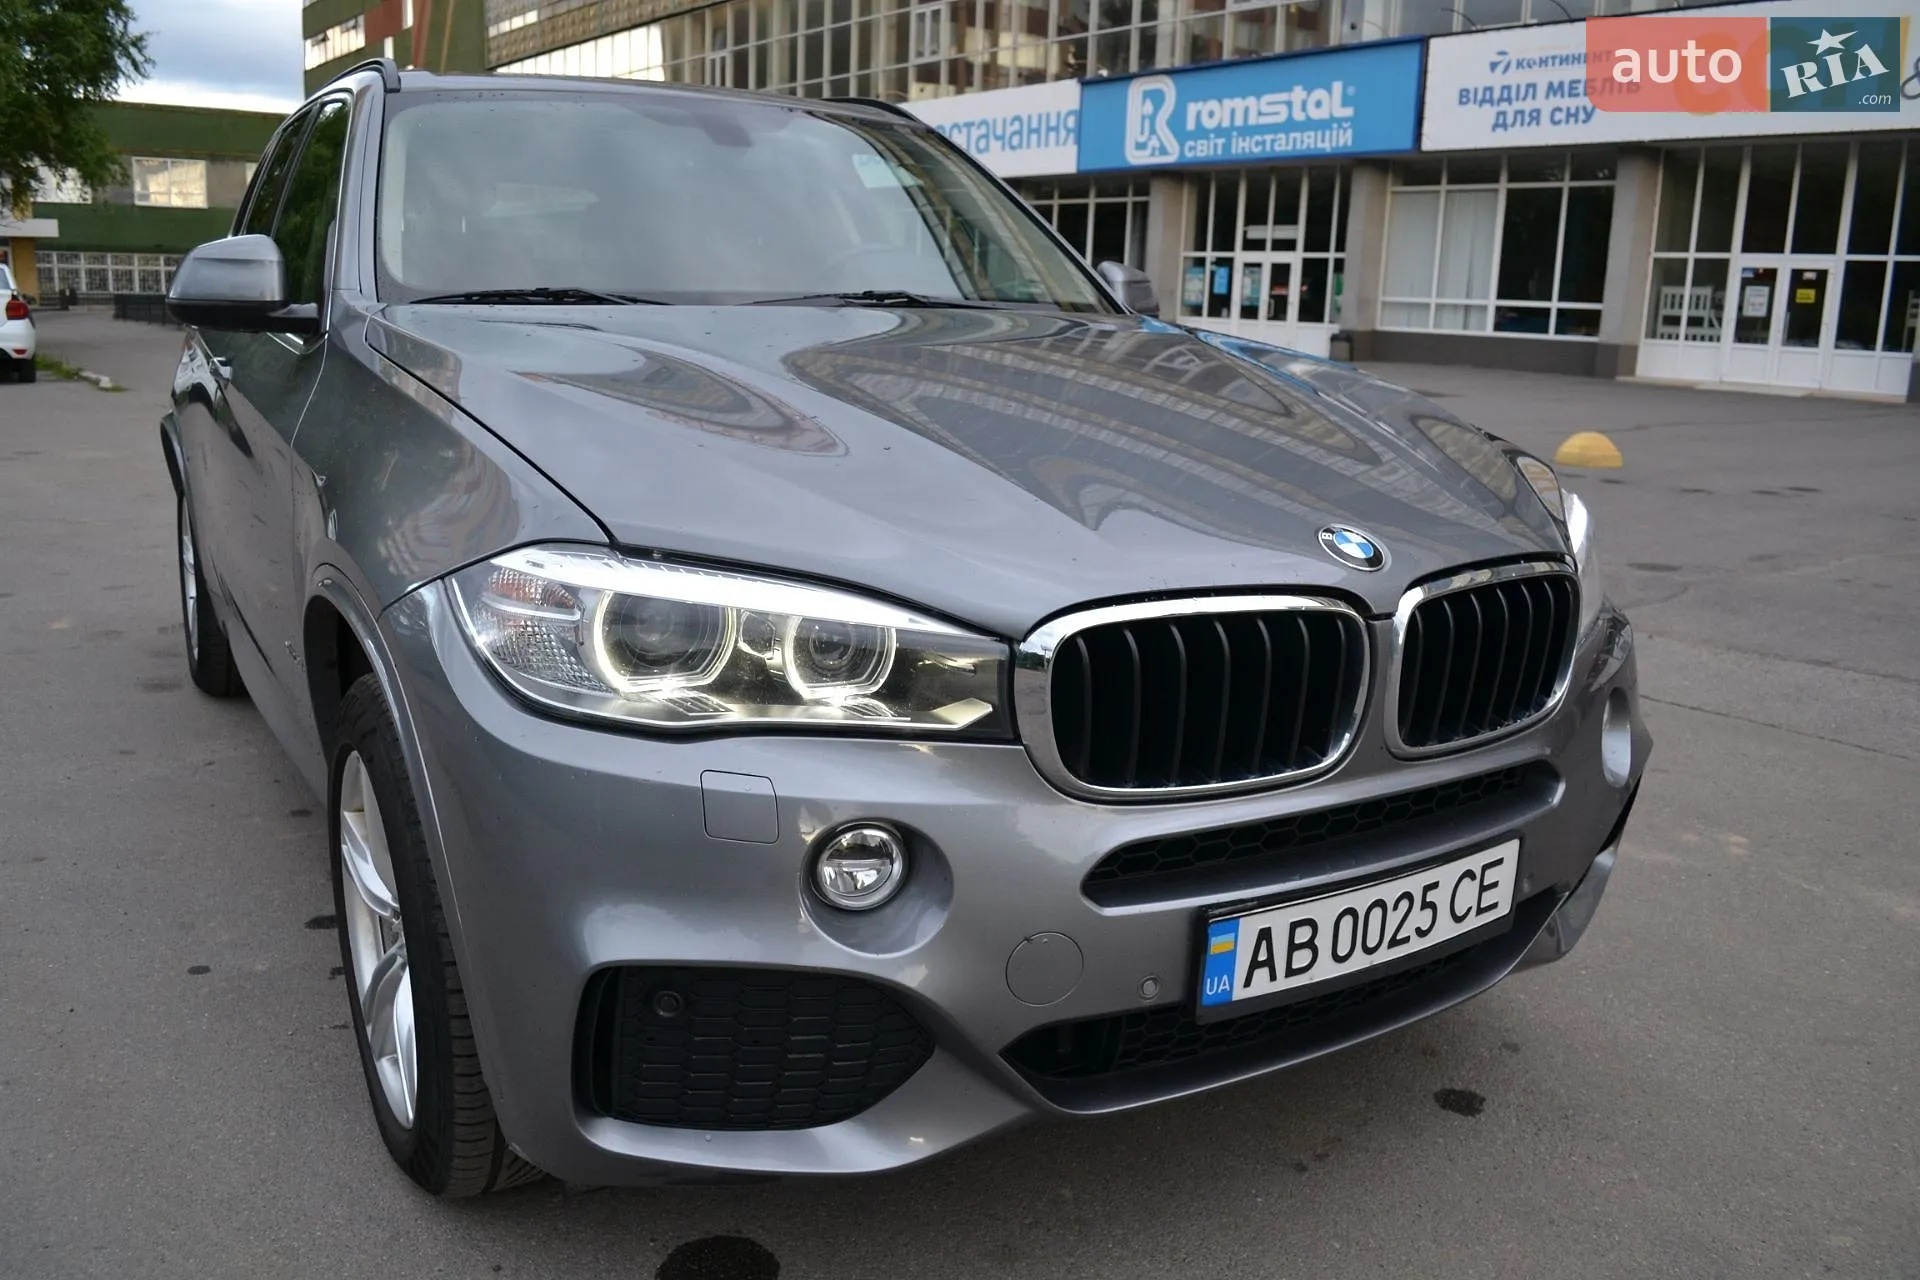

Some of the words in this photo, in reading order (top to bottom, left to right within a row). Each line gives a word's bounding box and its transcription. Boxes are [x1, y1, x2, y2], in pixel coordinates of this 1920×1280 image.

[1458, 82, 1538, 107] ВІДДІЛ
[1491, 108, 1542, 132] ДЛЯ
[1549, 104, 1596, 126] СНУ
[1184, 132, 1226, 158] світ
[1230, 121, 1353, 153] інсталяцій
[1243, 918, 1319, 988] AB
[1330, 880, 1440, 963] 0025
[1449, 857, 1505, 924] CE
[1205, 974, 1231, 996] UA
